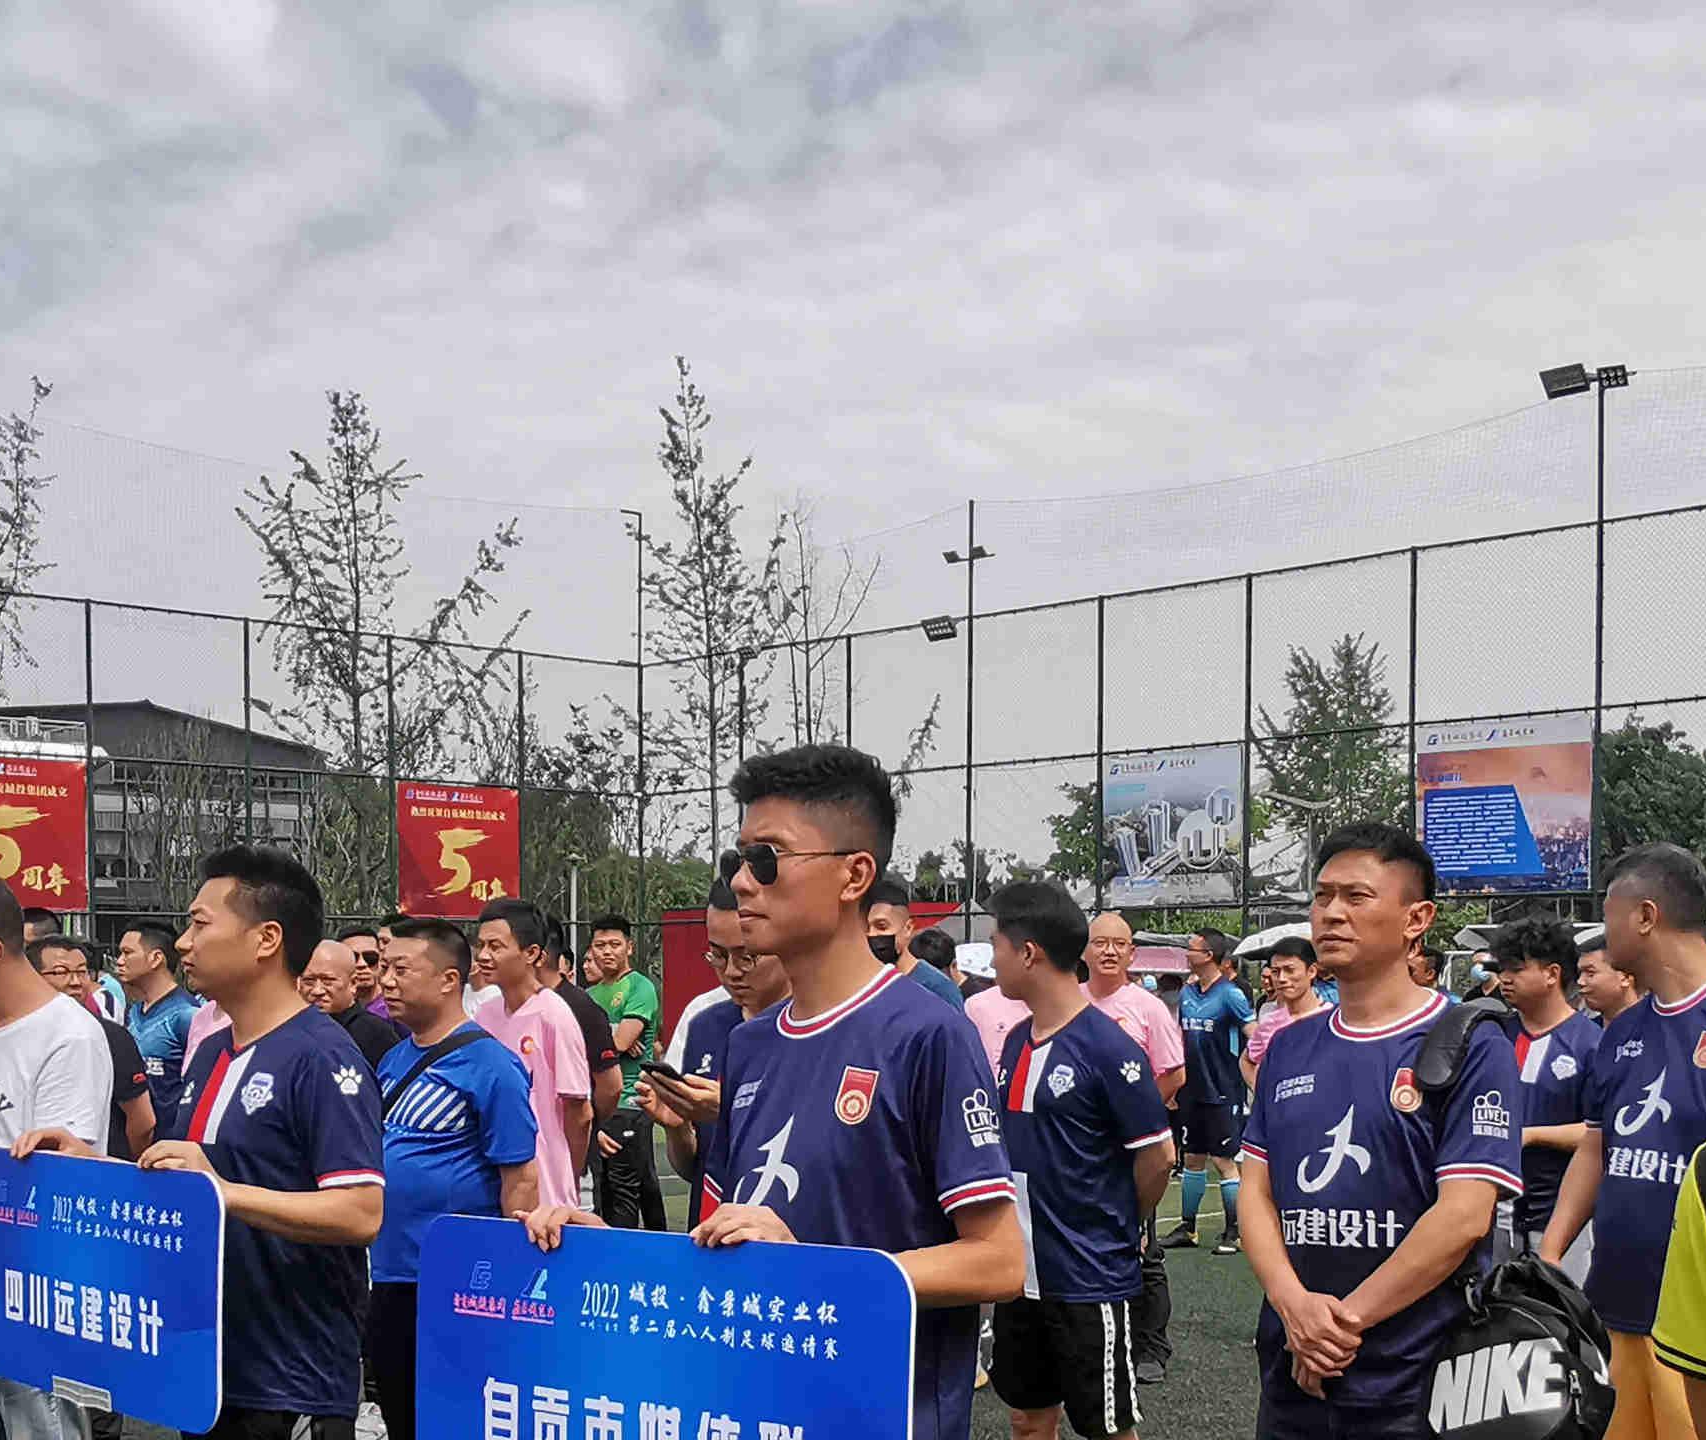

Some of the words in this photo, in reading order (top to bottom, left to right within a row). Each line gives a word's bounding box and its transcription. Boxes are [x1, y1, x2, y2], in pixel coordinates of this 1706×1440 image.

[21, 862, 71, 897] 周年
[431, 828, 492, 896] 5
[1477, 1108, 1502, 1122] LIVE
[1608, 1147, 1689, 1184] 建设计
[4, 1269, 164, 1357] 四川远建设计
[580, 1280, 620, 1319] 2022
[628, 1314, 839, 1361] 第二届八人制足球邀请赛
[1428, 1337, 1564, 1434] NIKE
